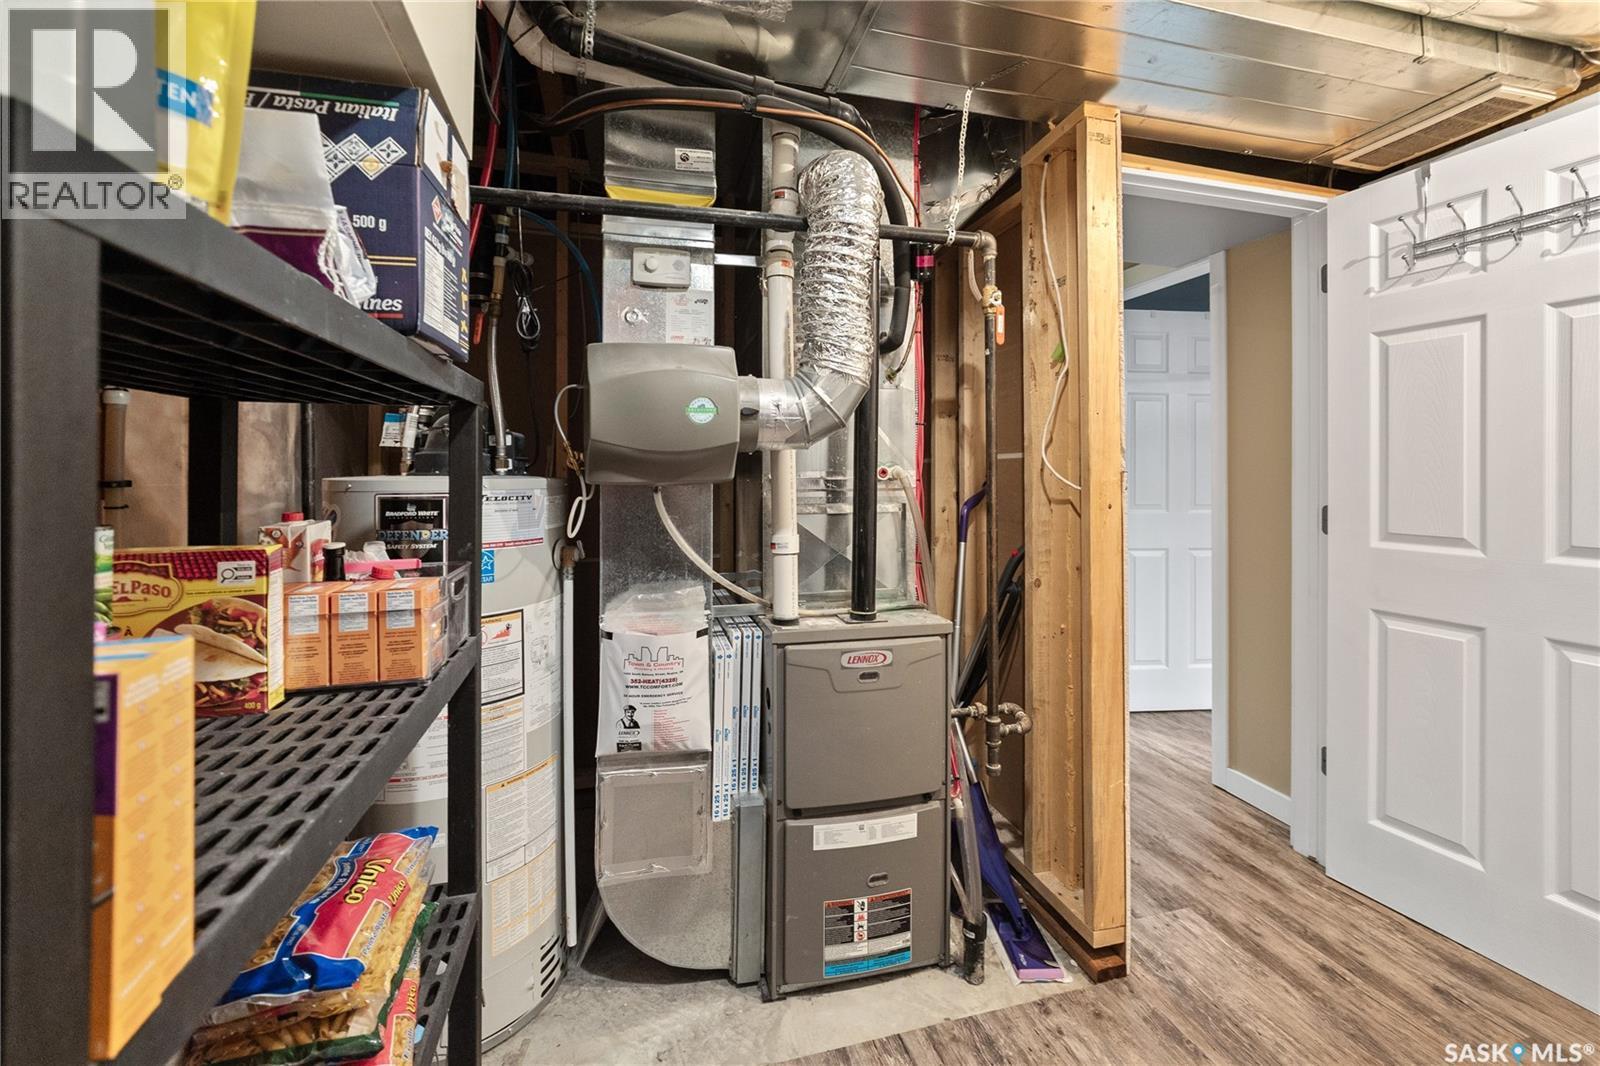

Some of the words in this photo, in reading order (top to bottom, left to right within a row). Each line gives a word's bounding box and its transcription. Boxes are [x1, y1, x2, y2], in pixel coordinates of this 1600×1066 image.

[273, 95, 330, 114] Pasta
[334, 101, 399, 121] Italian
[352, 214, 375, 229] 500
[378, 218, 387, 232] g
[378, 528, 449, 541] DEFENDER
[847, 654, 880, 664] LENNOX
[741, 768, 747, 776] 25
[752, 768, 758, 777] 25
[741, 782, 746, 790] 16
[752, 782, 757, 790] 16
[714, 795, 720, 804] 25
[723, 793, 729, 802] 25
[714, 810, 720, 818] 16
[344, 858, 392, 905] Unico
[388, 879, 406, 907] Unico
